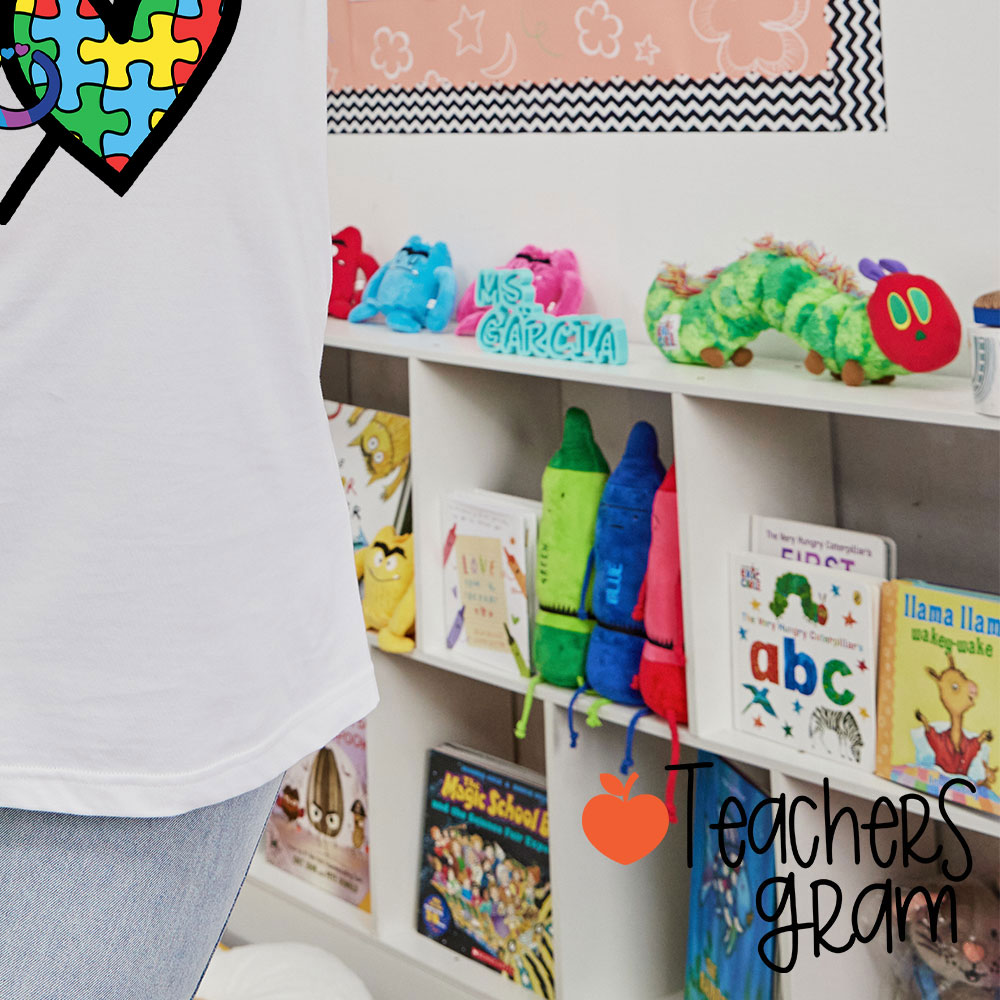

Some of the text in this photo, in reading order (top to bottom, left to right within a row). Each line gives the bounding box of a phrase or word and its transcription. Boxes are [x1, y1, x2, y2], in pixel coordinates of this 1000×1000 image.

[477, 312, 622, 365] GARCIA
[766, 529, 778, 540] The
[780, 532, 796, 544] Very
[797, 536, 824, 549] Hungry
[904, 593, 1000, 637] llama llam
[749, 636, 856, 706] abc
[440, 772, 487, 811] Magic
[486, 789, 541, 834] School
